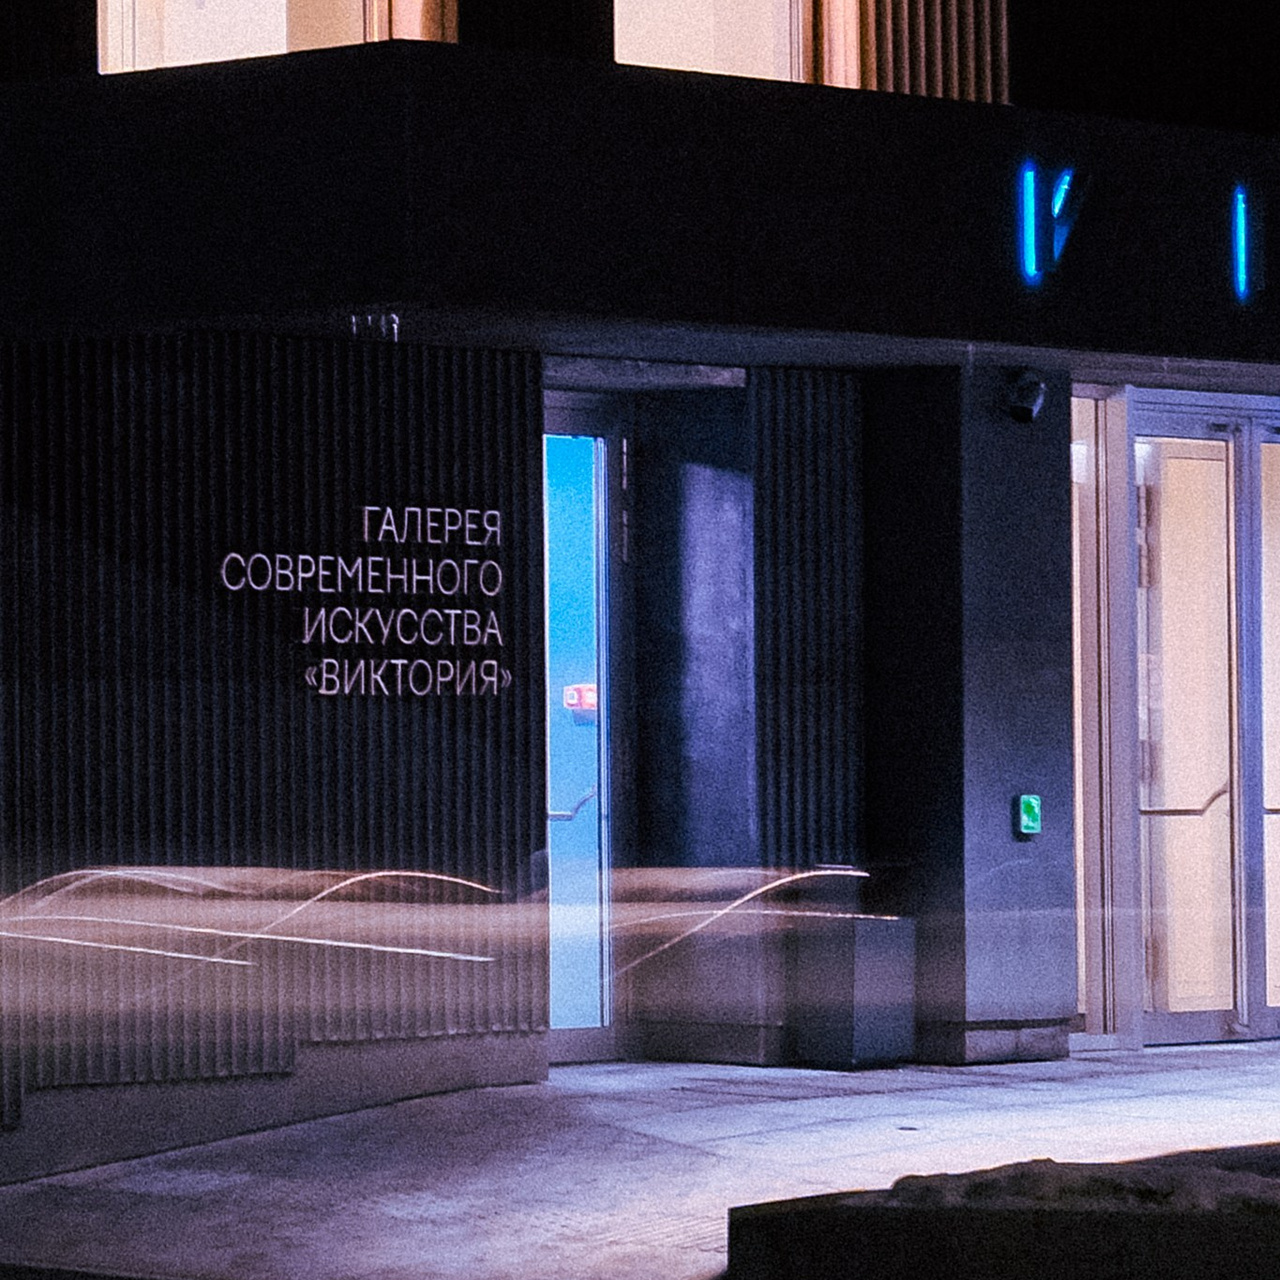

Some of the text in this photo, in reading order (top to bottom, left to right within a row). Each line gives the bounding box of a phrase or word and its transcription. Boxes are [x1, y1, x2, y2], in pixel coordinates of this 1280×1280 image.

[363, 506, 501, 545] ГАЛЕРЕЯ
[220, 552, 502, 597] СОВРЕМЕННОГО
[302, 606, 503, 646] ИСКУССТВА
[304, 658, 512, 697] «ВИКТОРИЯ»
